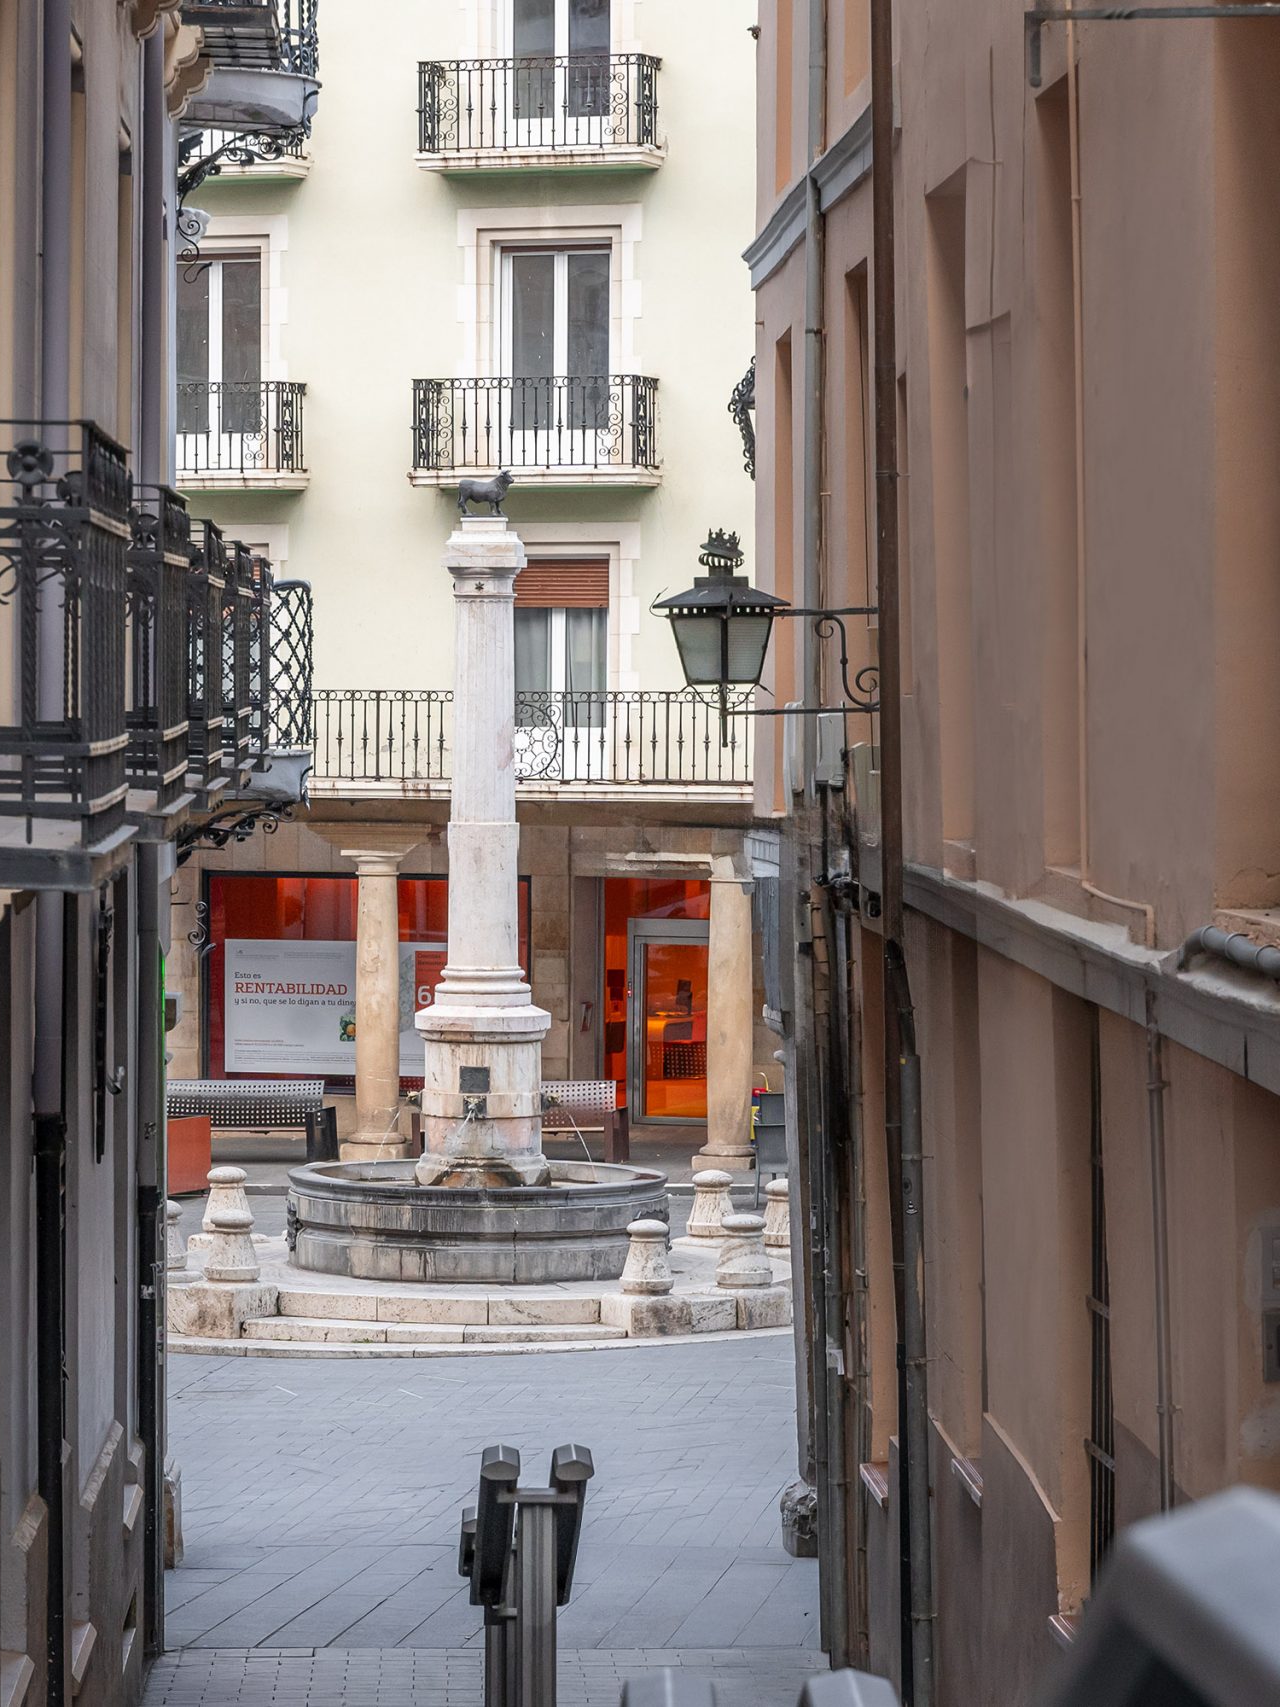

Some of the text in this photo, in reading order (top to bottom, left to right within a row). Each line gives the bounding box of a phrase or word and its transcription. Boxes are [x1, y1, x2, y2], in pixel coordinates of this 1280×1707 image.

[234, 971, 251, 979] Esto
[234, 982, 348, 996] RENTABILIDAD
[417, 985, 432, 1005] 6
[234, 998, 240, 1006] y
[288, 997, 297, 1005] lo
[297, 998, 320, 1007] digan
